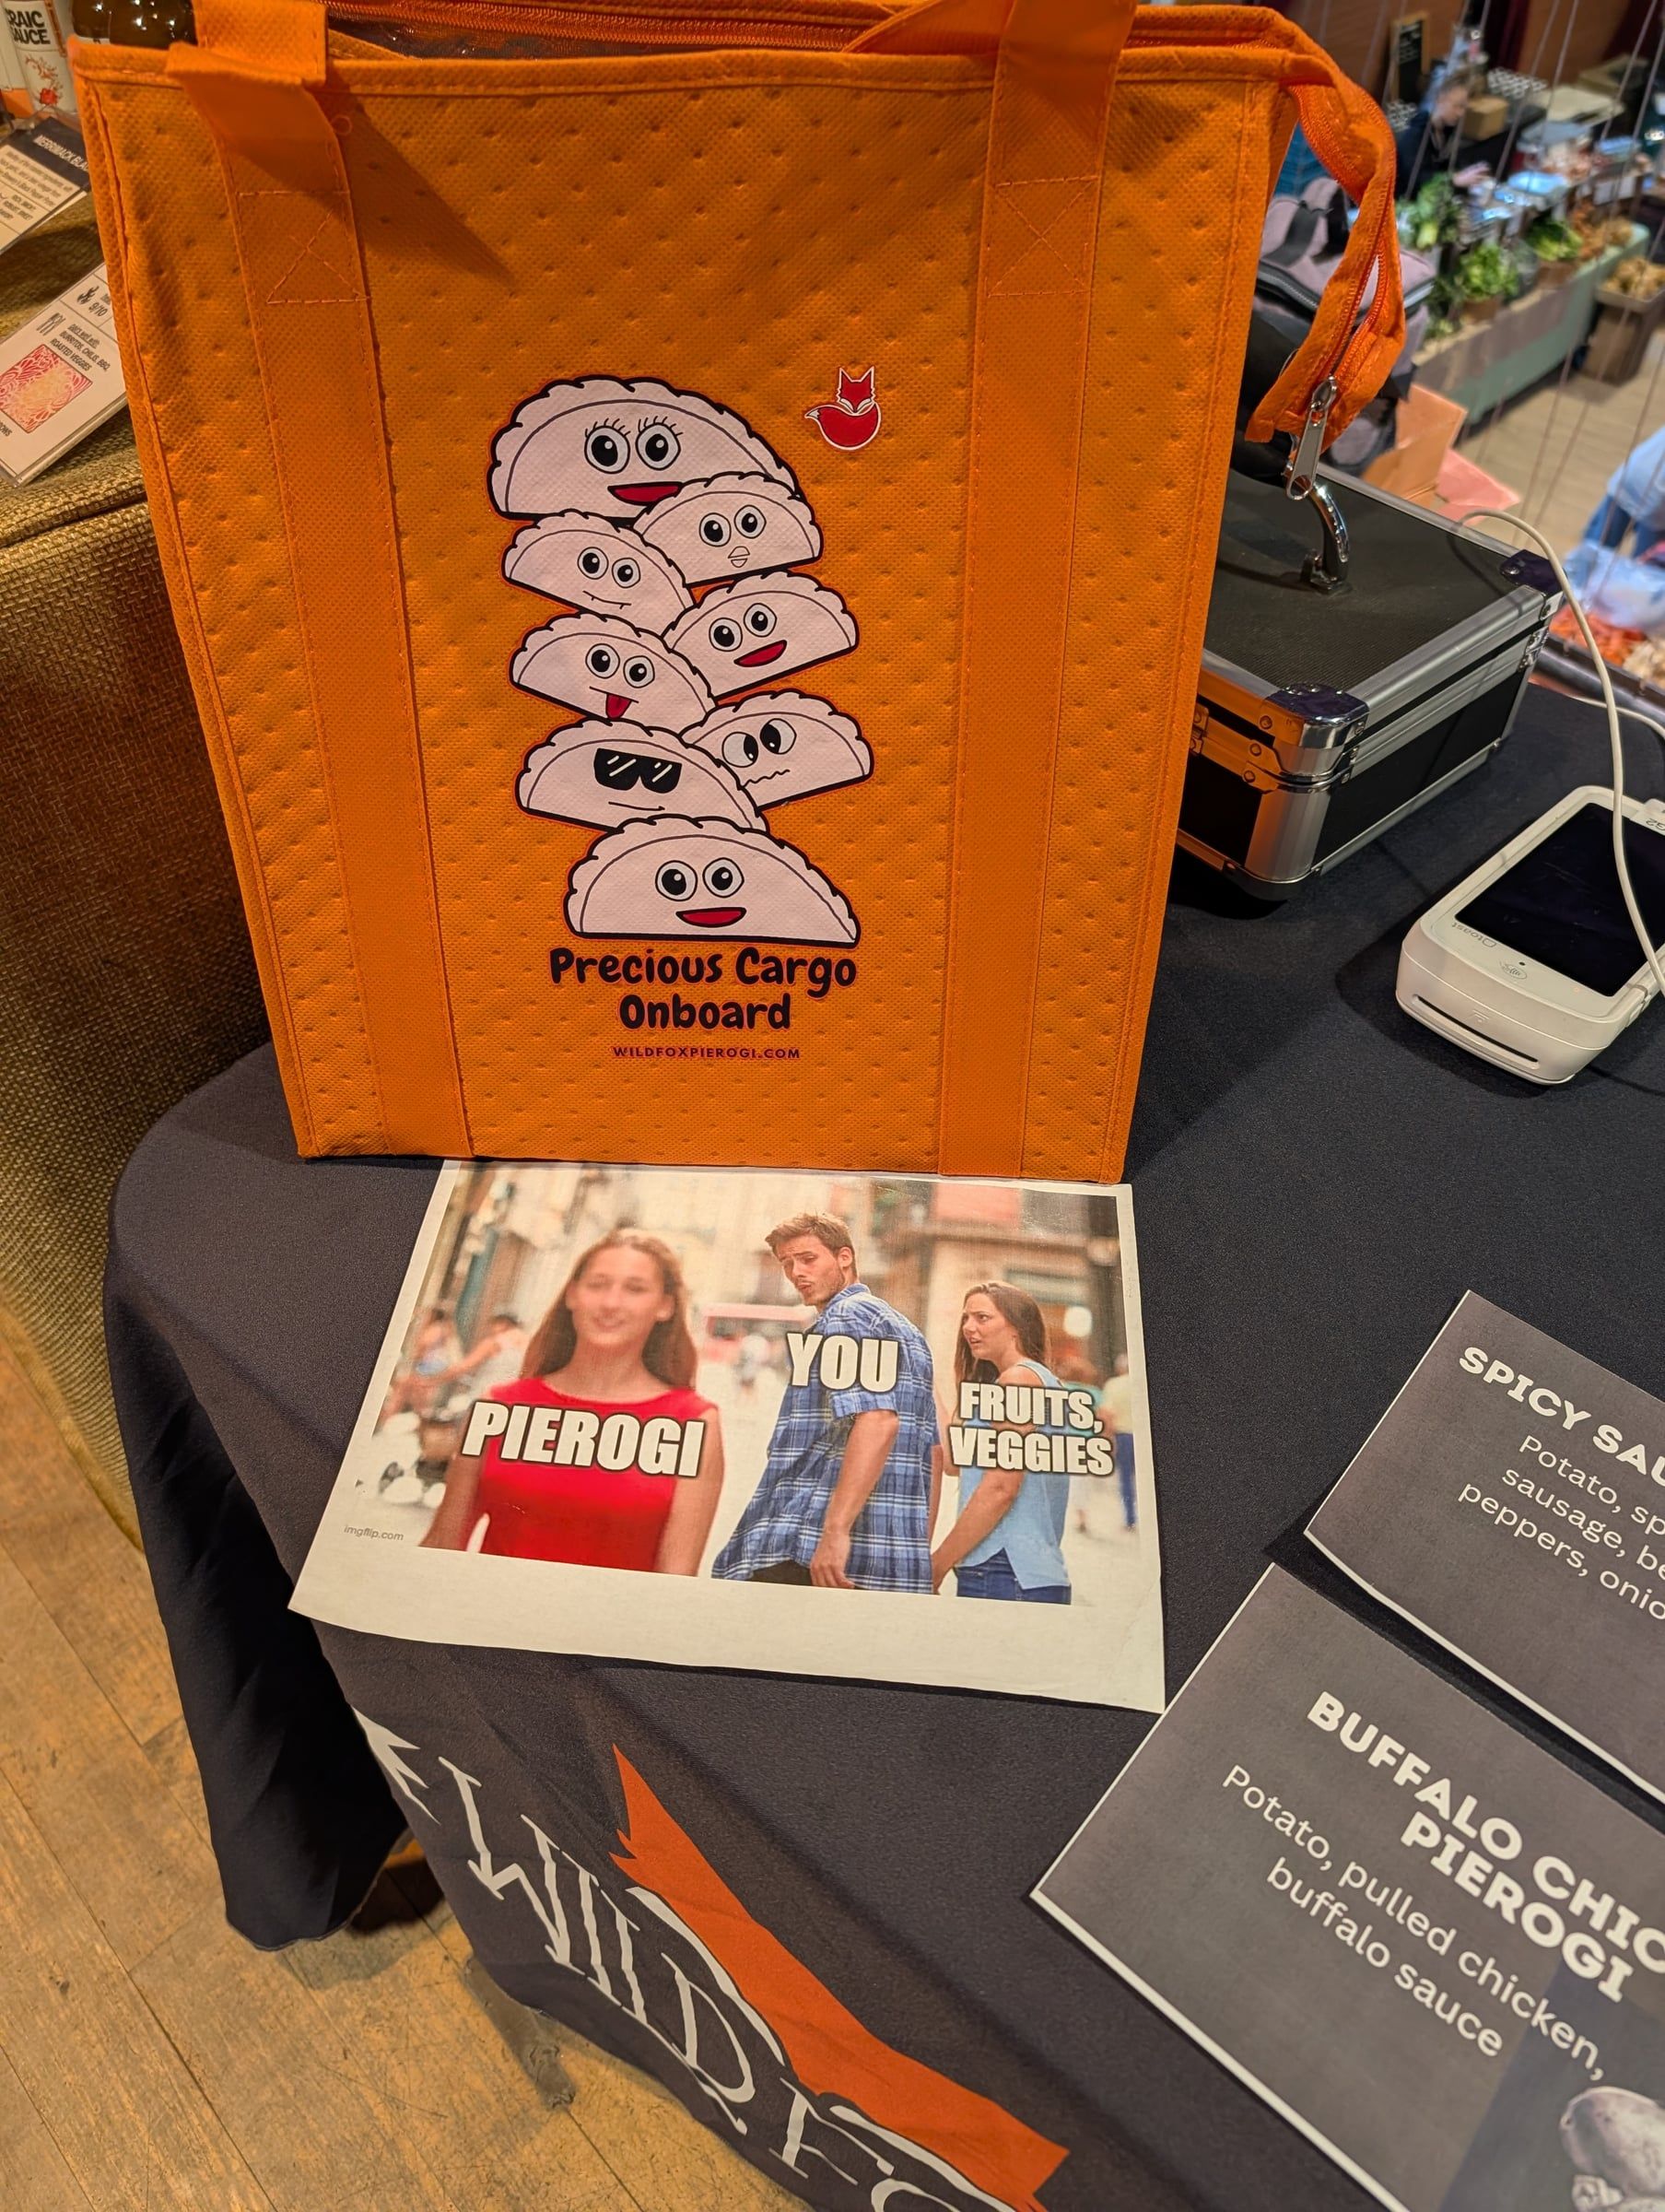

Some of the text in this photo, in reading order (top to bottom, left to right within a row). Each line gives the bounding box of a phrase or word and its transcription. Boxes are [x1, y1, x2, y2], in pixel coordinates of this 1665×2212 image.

[9, 26, 51, 45] AUCE
[88, 302, 108, 317] 9/10
[50, 337, 92, 371] ROASTED VEGGIES
[550, 947, 858, 998] Precious Cargo
[618, 993, 791, 1030] Onboard
[613, 1047, 801, 1059] WILDFOXPIEROGI.COM
[786, 1333, 898, 1394] YOU
[1459, 1347, 1592, 1430] SPICY
[461, 1400, 706, 1478] PIEROGI
[959, 1381, 1105, 1434] FRUITS,
[948, 1425, 1116, 1477] VEGGIES
[1518, 1434, 1665, 1536] Potato, sp
[344, 1524, 405, 1541] imgflip.com
[1458, 1483, 1589, 1578] peppers,
[1502, 1467, 1626, 1559] sausage,
[1307, 1690, 1665, 1974] BUFFALO CHIC
[1222, 1764, 1605, 2081] Potato, pulled chicken,
[1401, 1811, 1634, 2003] PIEROGI
[439, 1755, 756, 2136] WILD
[1266, 1857, 1504, 2058] buffalo sauce
